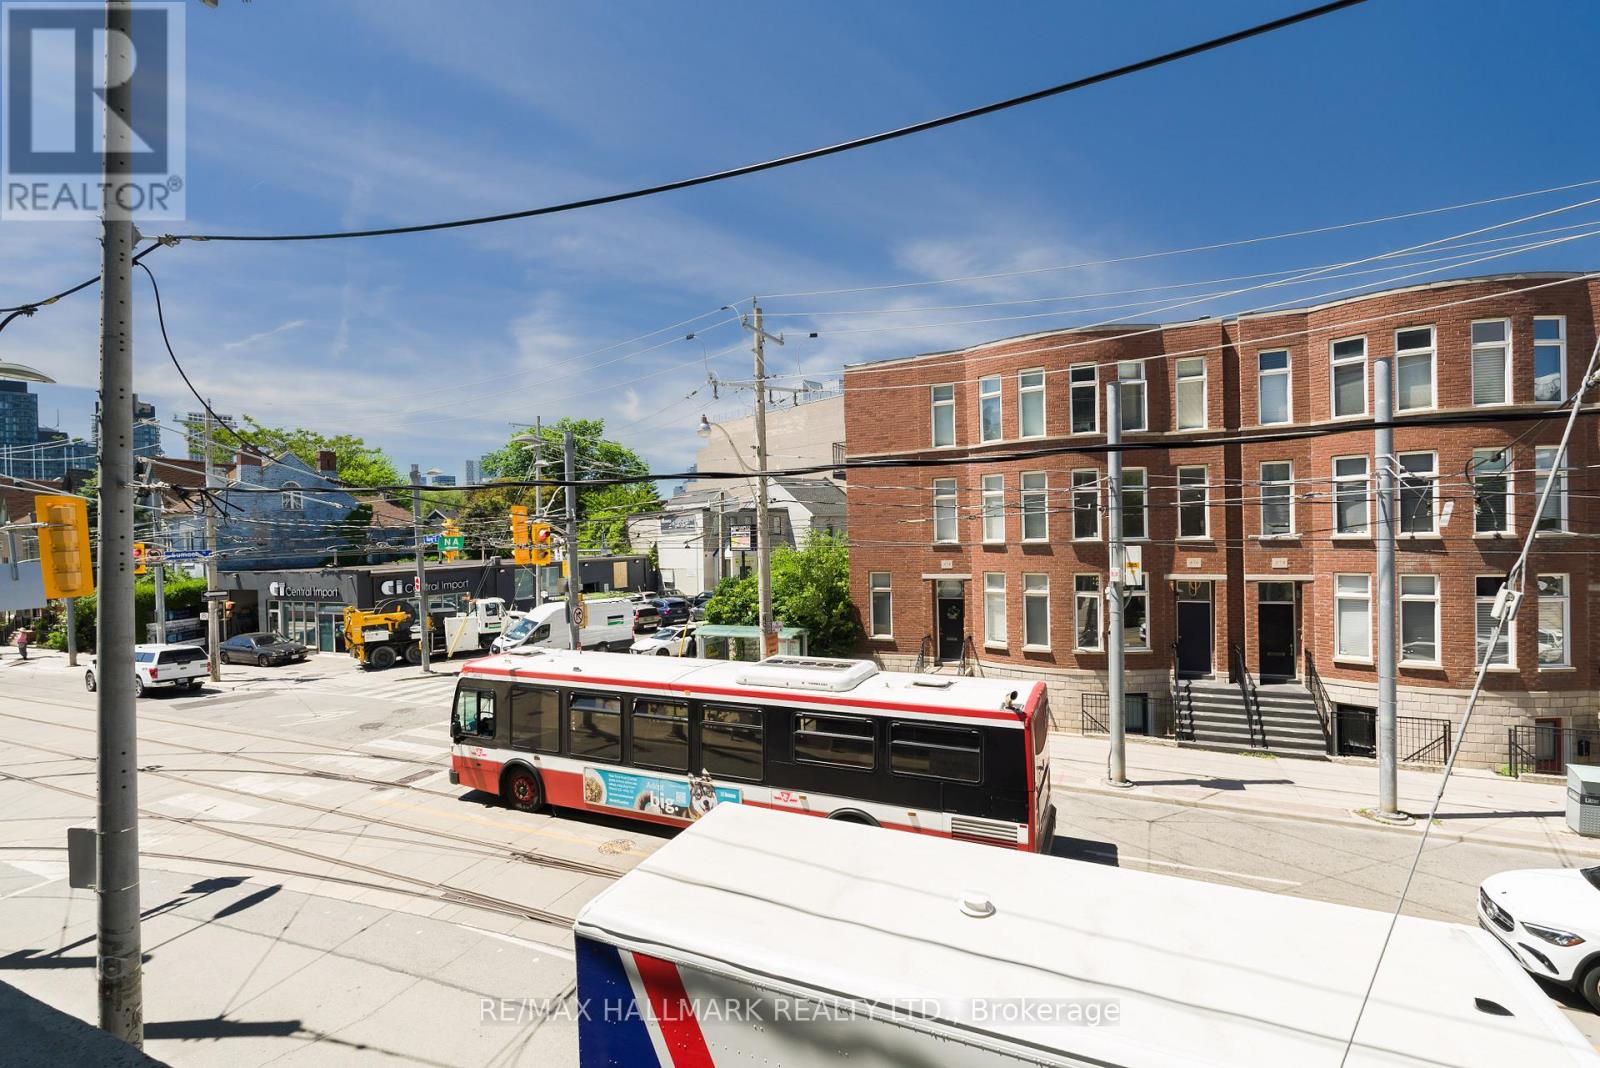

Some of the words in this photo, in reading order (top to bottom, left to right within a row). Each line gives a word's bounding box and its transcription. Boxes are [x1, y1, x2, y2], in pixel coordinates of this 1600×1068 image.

[442, 580, 468, 590] Import
[286, 587, 312, 596] Central
[314, 587, 338, 598] Import
[650, 791, 678, 814] big.
